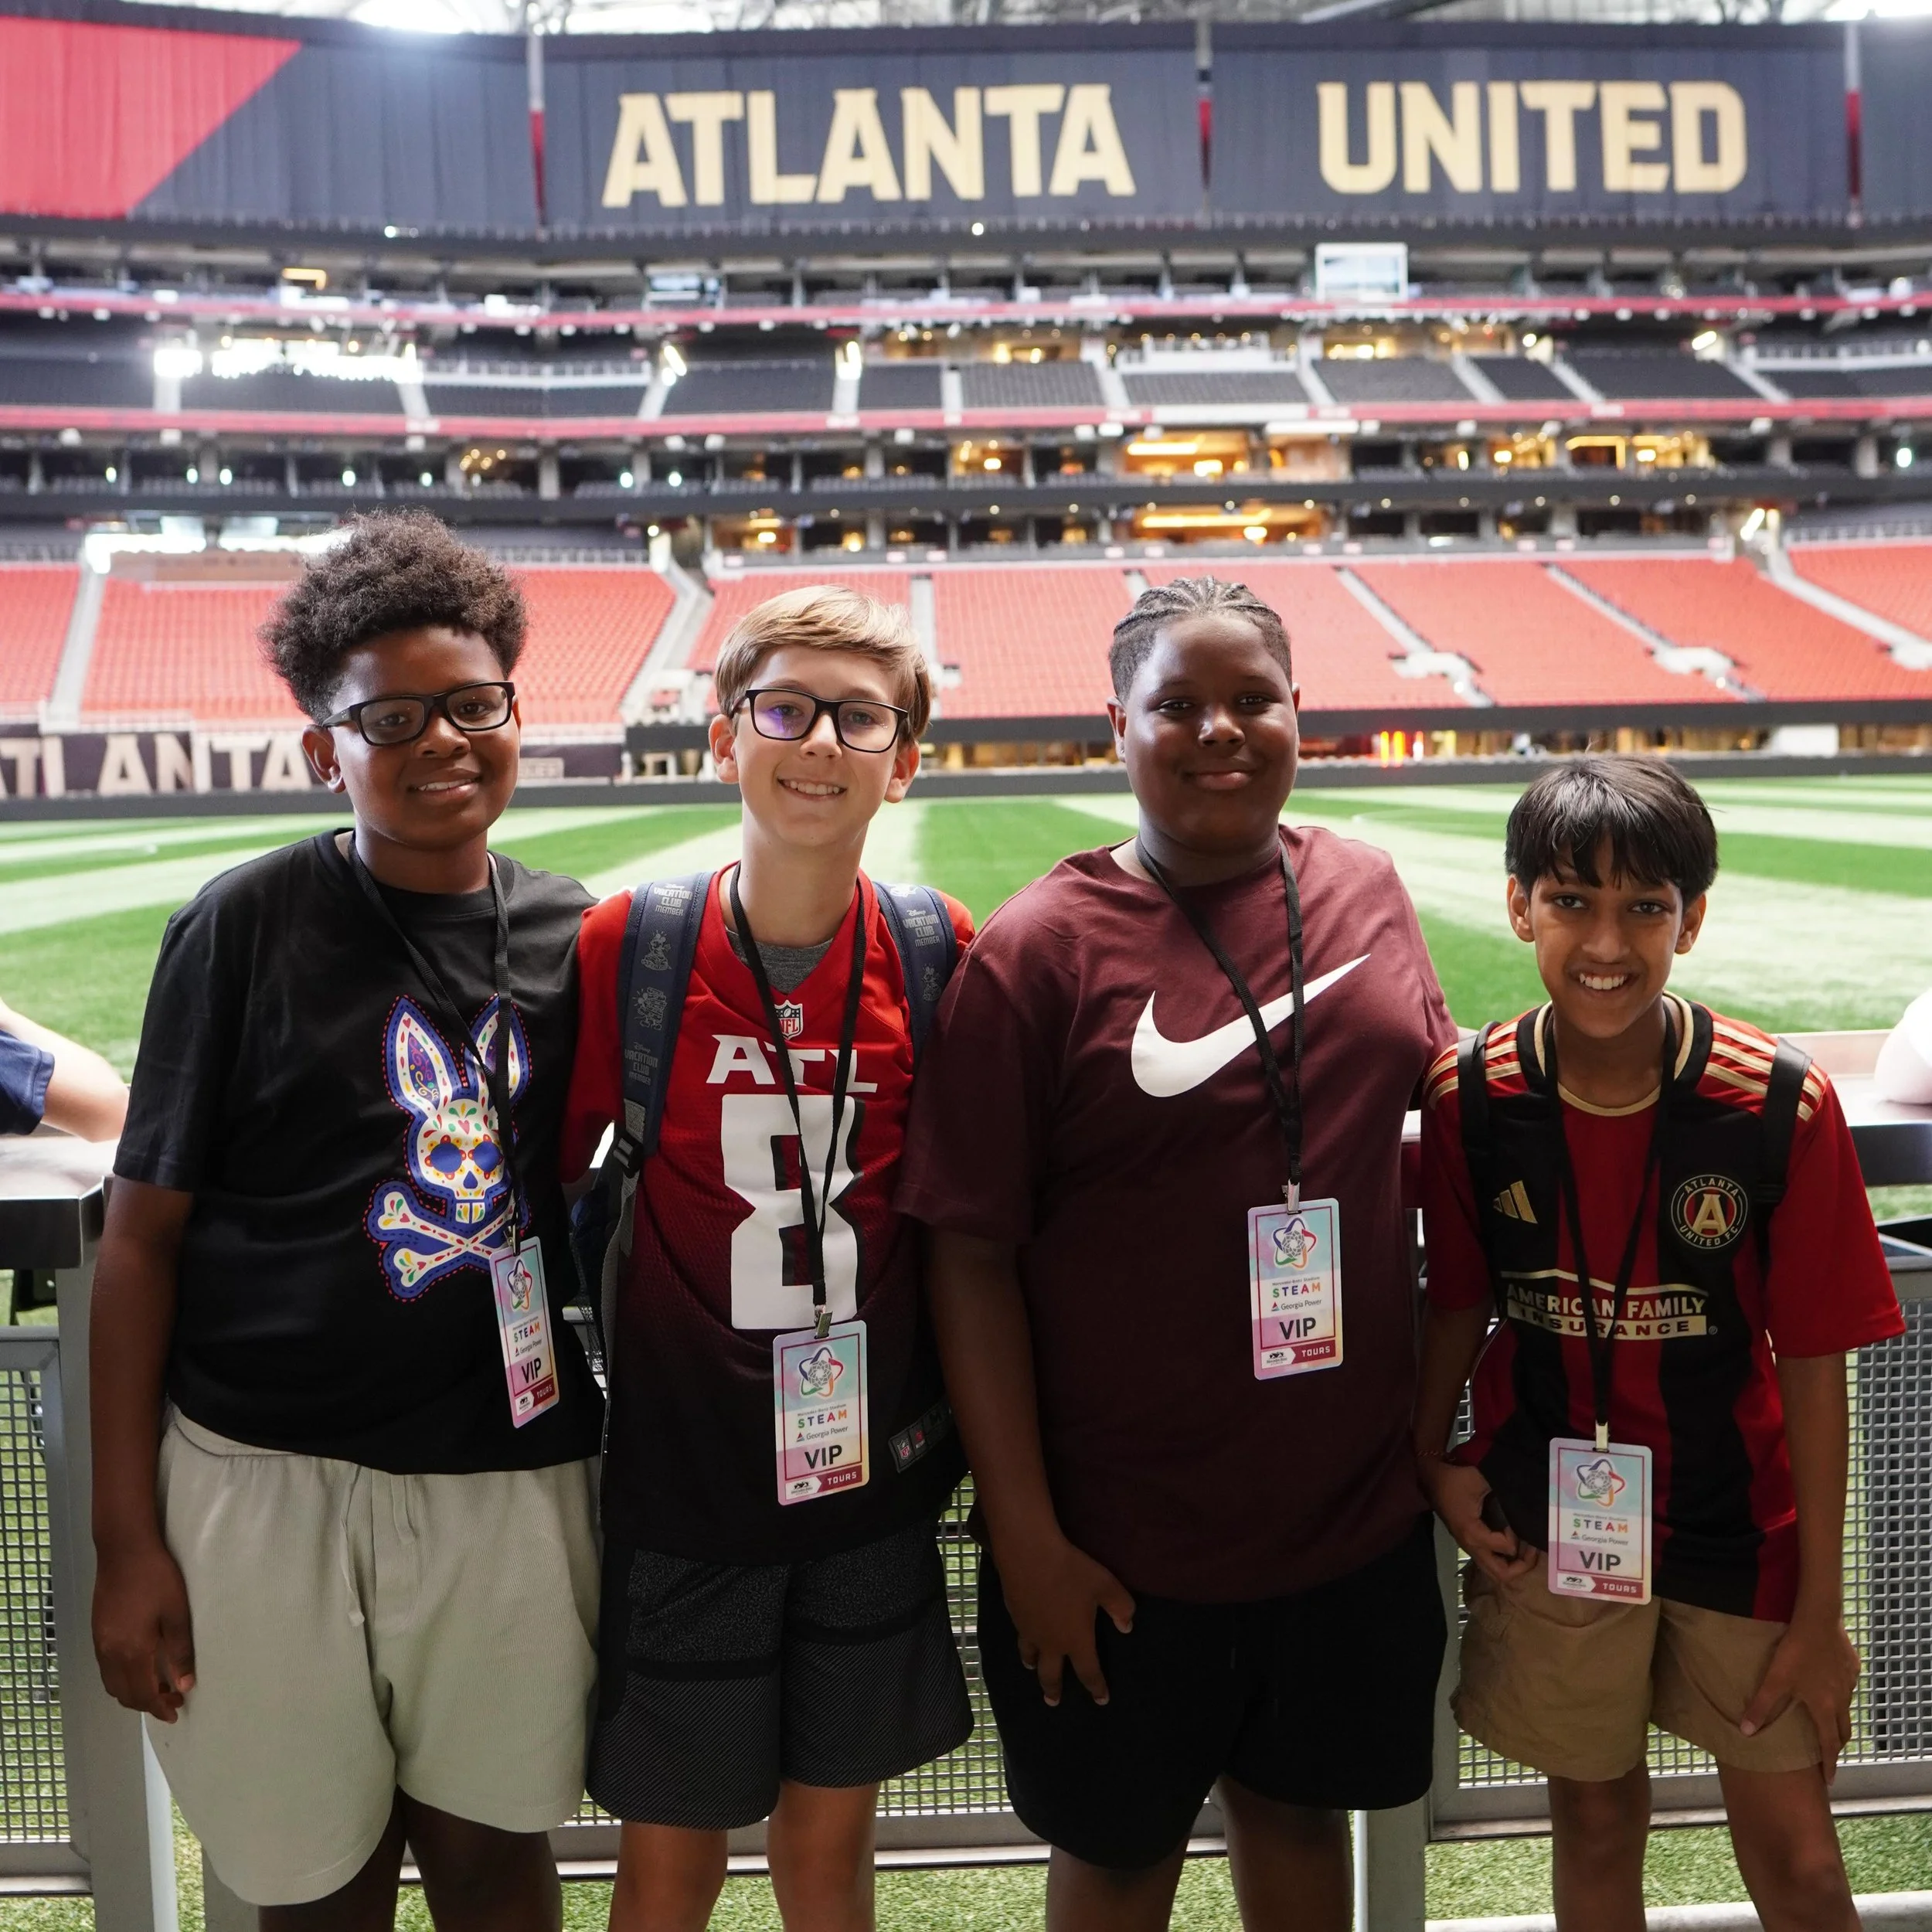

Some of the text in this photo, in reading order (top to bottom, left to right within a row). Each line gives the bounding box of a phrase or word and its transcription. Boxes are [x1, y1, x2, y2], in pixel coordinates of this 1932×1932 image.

[601, 81, 1747, 207] ATLANTA UNITED
[0, 733, 311, 800] TLANTA
[654, 887, 692, 900] VACATION
[662, 896, 682, 907] CLUB
[655, 905, 683, 916] MEMBER
[903, 914, 938, 928] VACATION
[915, 926, 935, 937] CLUB
[915, 936, 940, 947] MEMBER
[634, 1062, 649, 1076] CLUB
[706, 1035, 879, 1094] ATL
[1685, 1178, 1739, 1196] ATLANTA
[721, 1094, 859, 1330] 8
[1679, 1224, 1738, 1247] UNITED FC
[1273, 1282, 1320, 1298] STEAM
[1281, 1302, 1303, 1311] Georgia
[1628, 1297, 1706, 1318] FAMILY
[514, 1321, 540, 1342] STEAM
[1280, 1317, 1316, 1340] VIP
[1301, 1346, 1331, 1357] TOURS
[522, 1357, 541, 1383] VIP
[536, 1385, 552, 1399] TOURS
[798, 1410, 847, 1428] STEAM
[807, 1430, 829, 1440] Georgia
[804, 1445, 842, 1468] VIP
[827, 1471, 856, 1485] TOURS
[1573, 1519, 1628, 1533] STEAM
[1581, 1535, 1607, 1544] Georgia
[1580, 1550, 1621, 1571] VIP
[1603, 1583, 1637, 1594] TOURS
